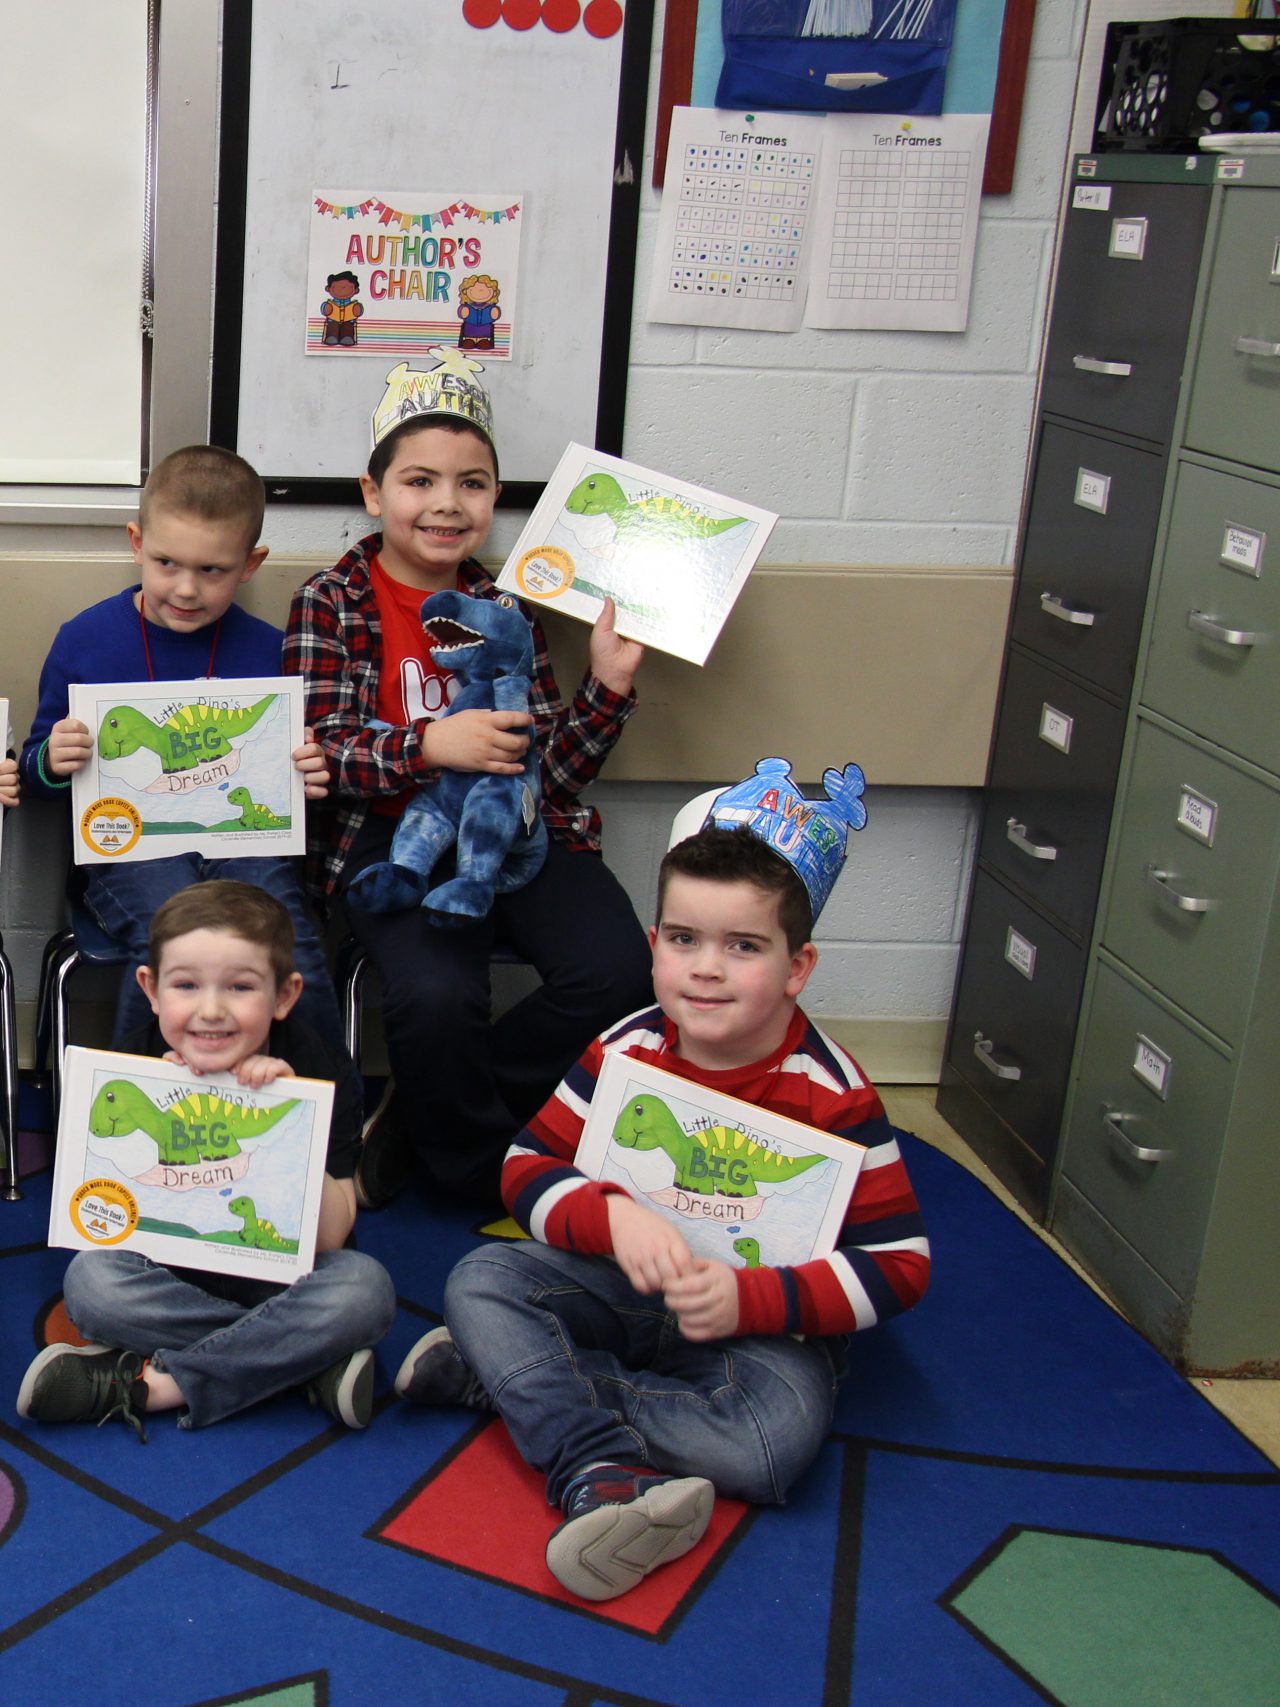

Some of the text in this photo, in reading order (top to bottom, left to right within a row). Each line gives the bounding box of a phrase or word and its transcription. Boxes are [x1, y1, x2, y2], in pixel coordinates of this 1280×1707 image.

[720, 130, 787, 147] Ten Frames
[873, 134, 942, 147] Ten Frames
[345, 234, 481, 270] AUTHOR'S
[369, 269, 451, 303] CHAIR
[627, 489, 660, 502] Little
[1083, 483, 1097, 495] ELA
[153, 696, 241, 726] Little Dino's
[169, 726, 221, 760] BIG
[168, 763, 229, 792] Dream
[1142, 1047, 1160, 1075] Math
[156, 1085, 257, 1109] Little Dino's
[171, 1119, 230, 1150] BIG
[683, 1116, 783, 1154] Little Dino's
[162, 1165, 234, 1186] Dream
[689, 1147, 749, 1185] BIG
[85, 1200, 98, 1210] Love
[98, 1206, 109, 1215] This
[673, 1191, 745, 1220] Dream
